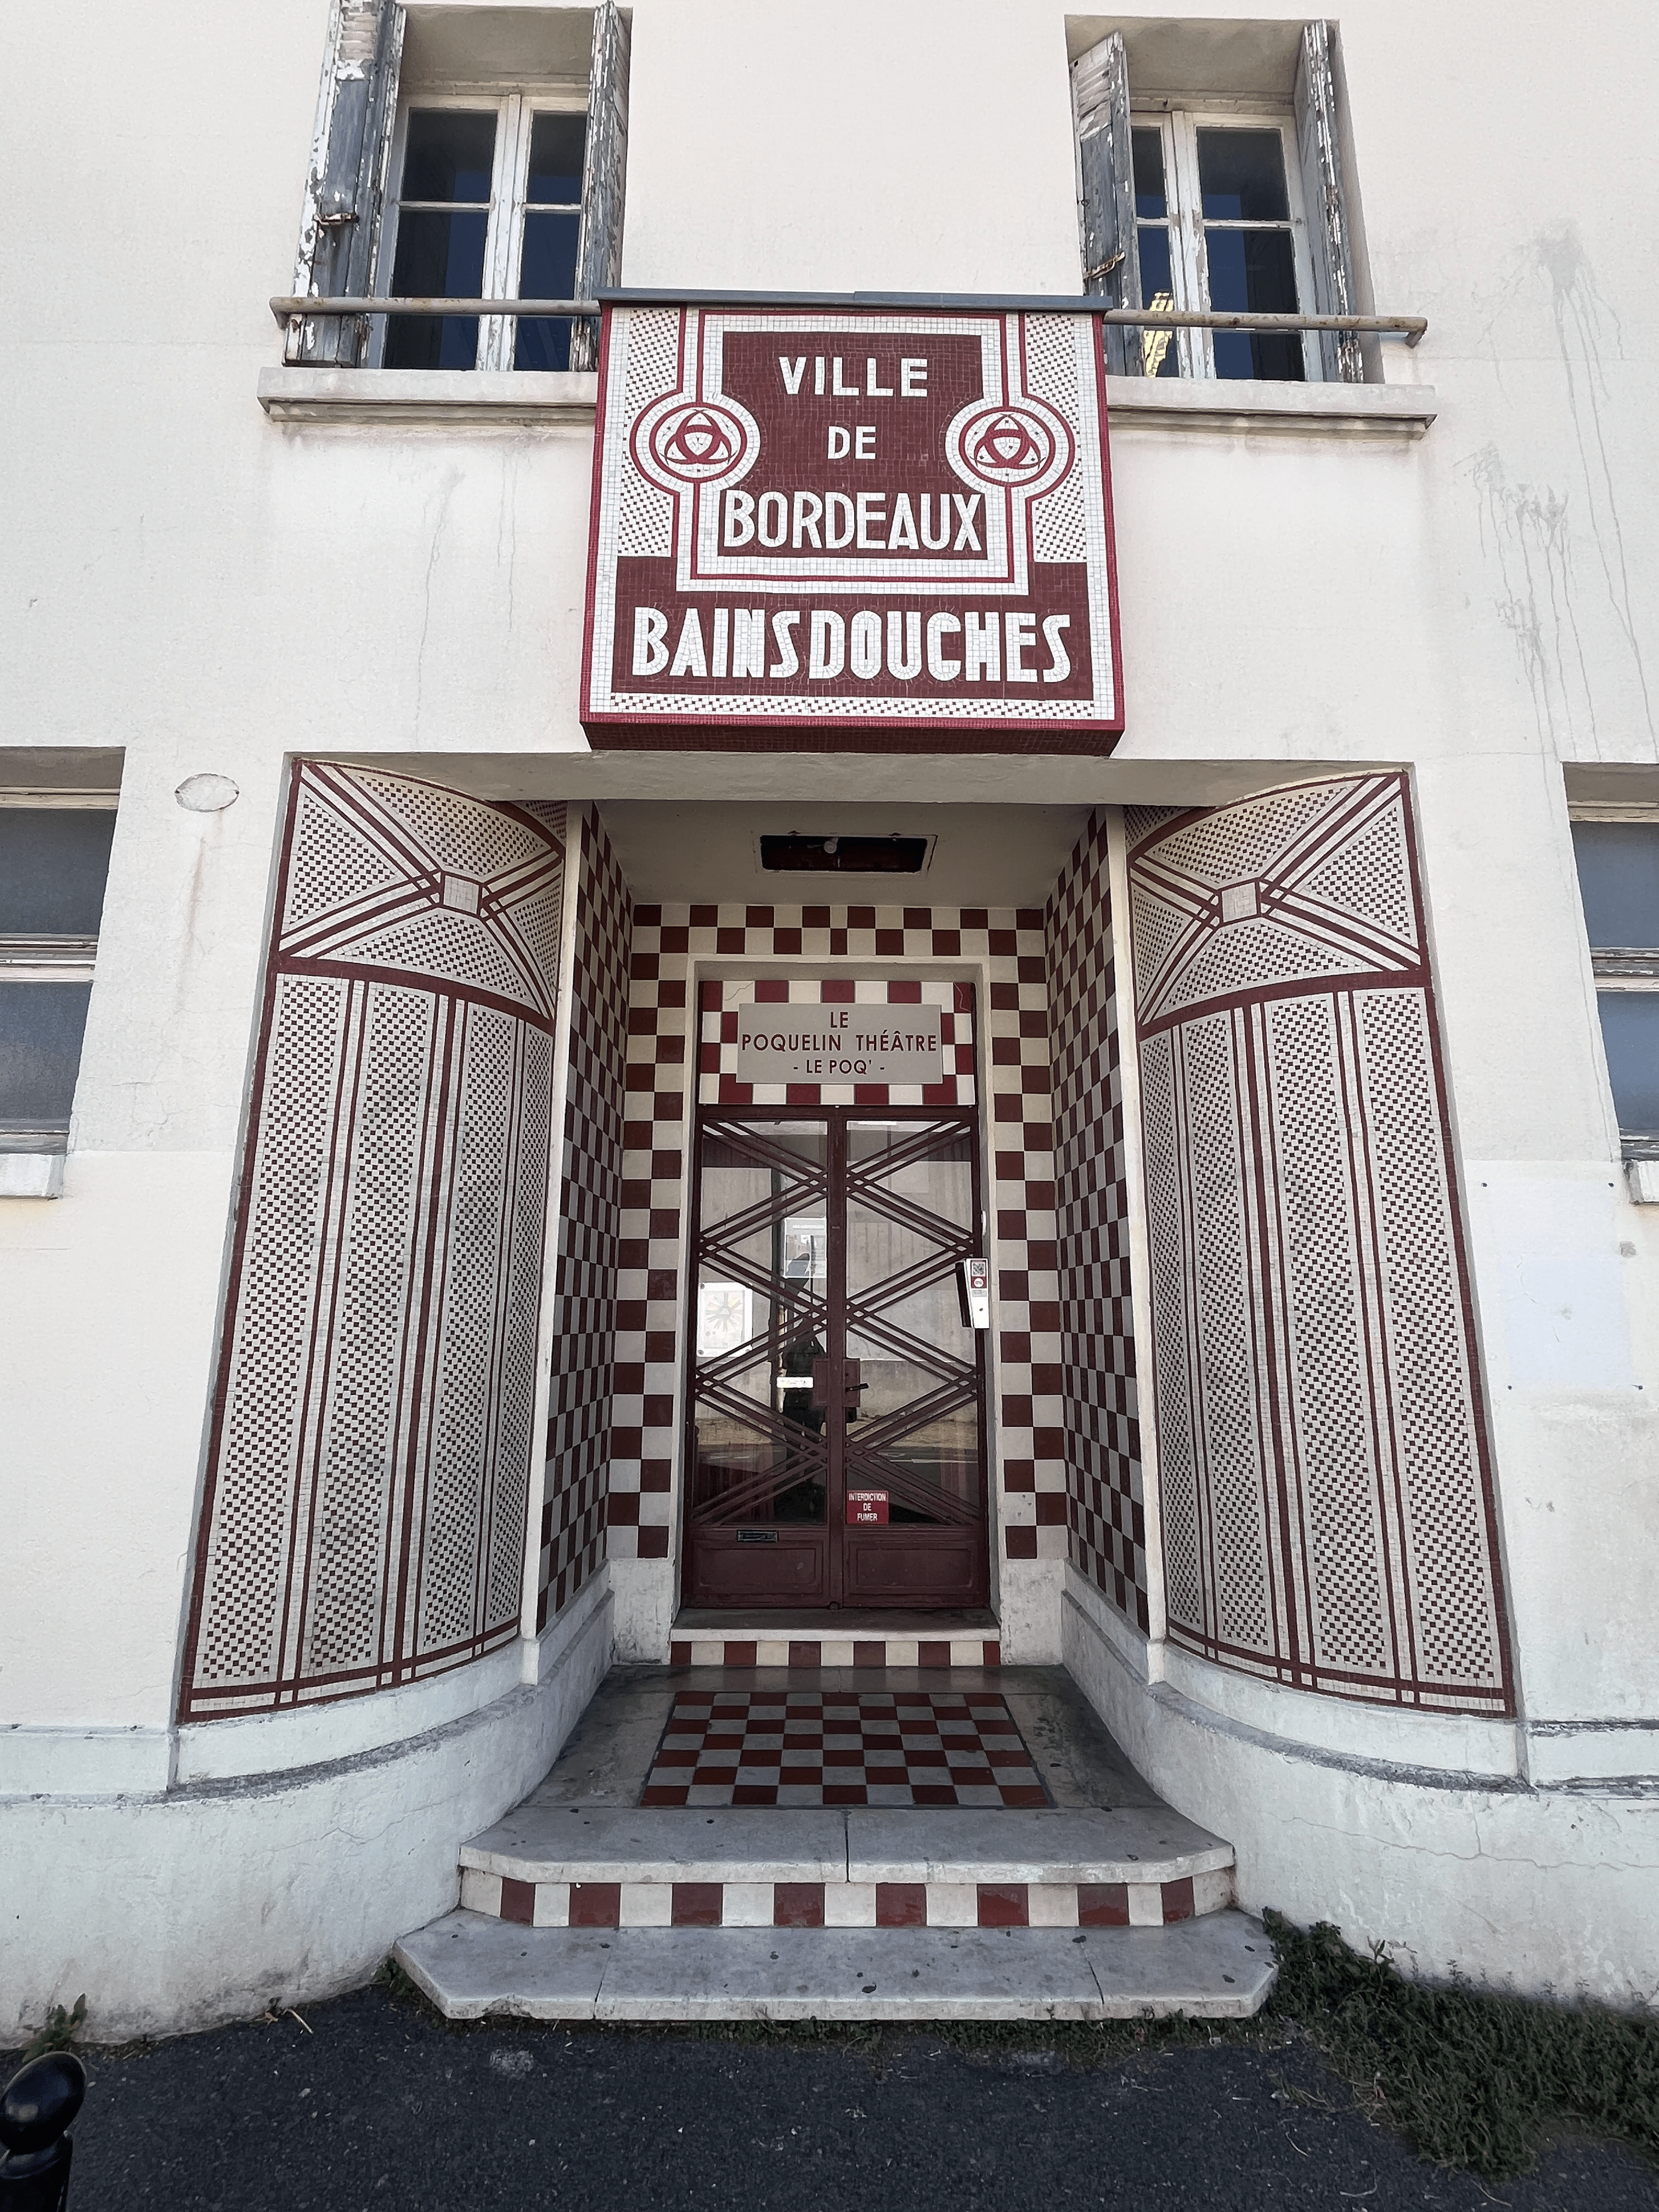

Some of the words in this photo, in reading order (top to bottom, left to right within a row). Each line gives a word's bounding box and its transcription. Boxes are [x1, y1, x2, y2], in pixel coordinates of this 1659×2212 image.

[779, 356, 927, 397] VILLE
[827, 426, 876, 460] DE
[724, 489, 982, 551] BORDEAUX
[830, 1012, 848, 1028] LE
[742, 1034, 841, 1052] POQUELIN
[855, 1029, 936, 1052] THÉÂTRE
[806, 1059, 822, 1074] LE
[829, 1059, 872, 1075] POQ'
[848, 1492, 886, 1502] INTERDICTION
[863, 1503, 872, 1511] DE
[857, 1513, 878, 1522] FUMER
